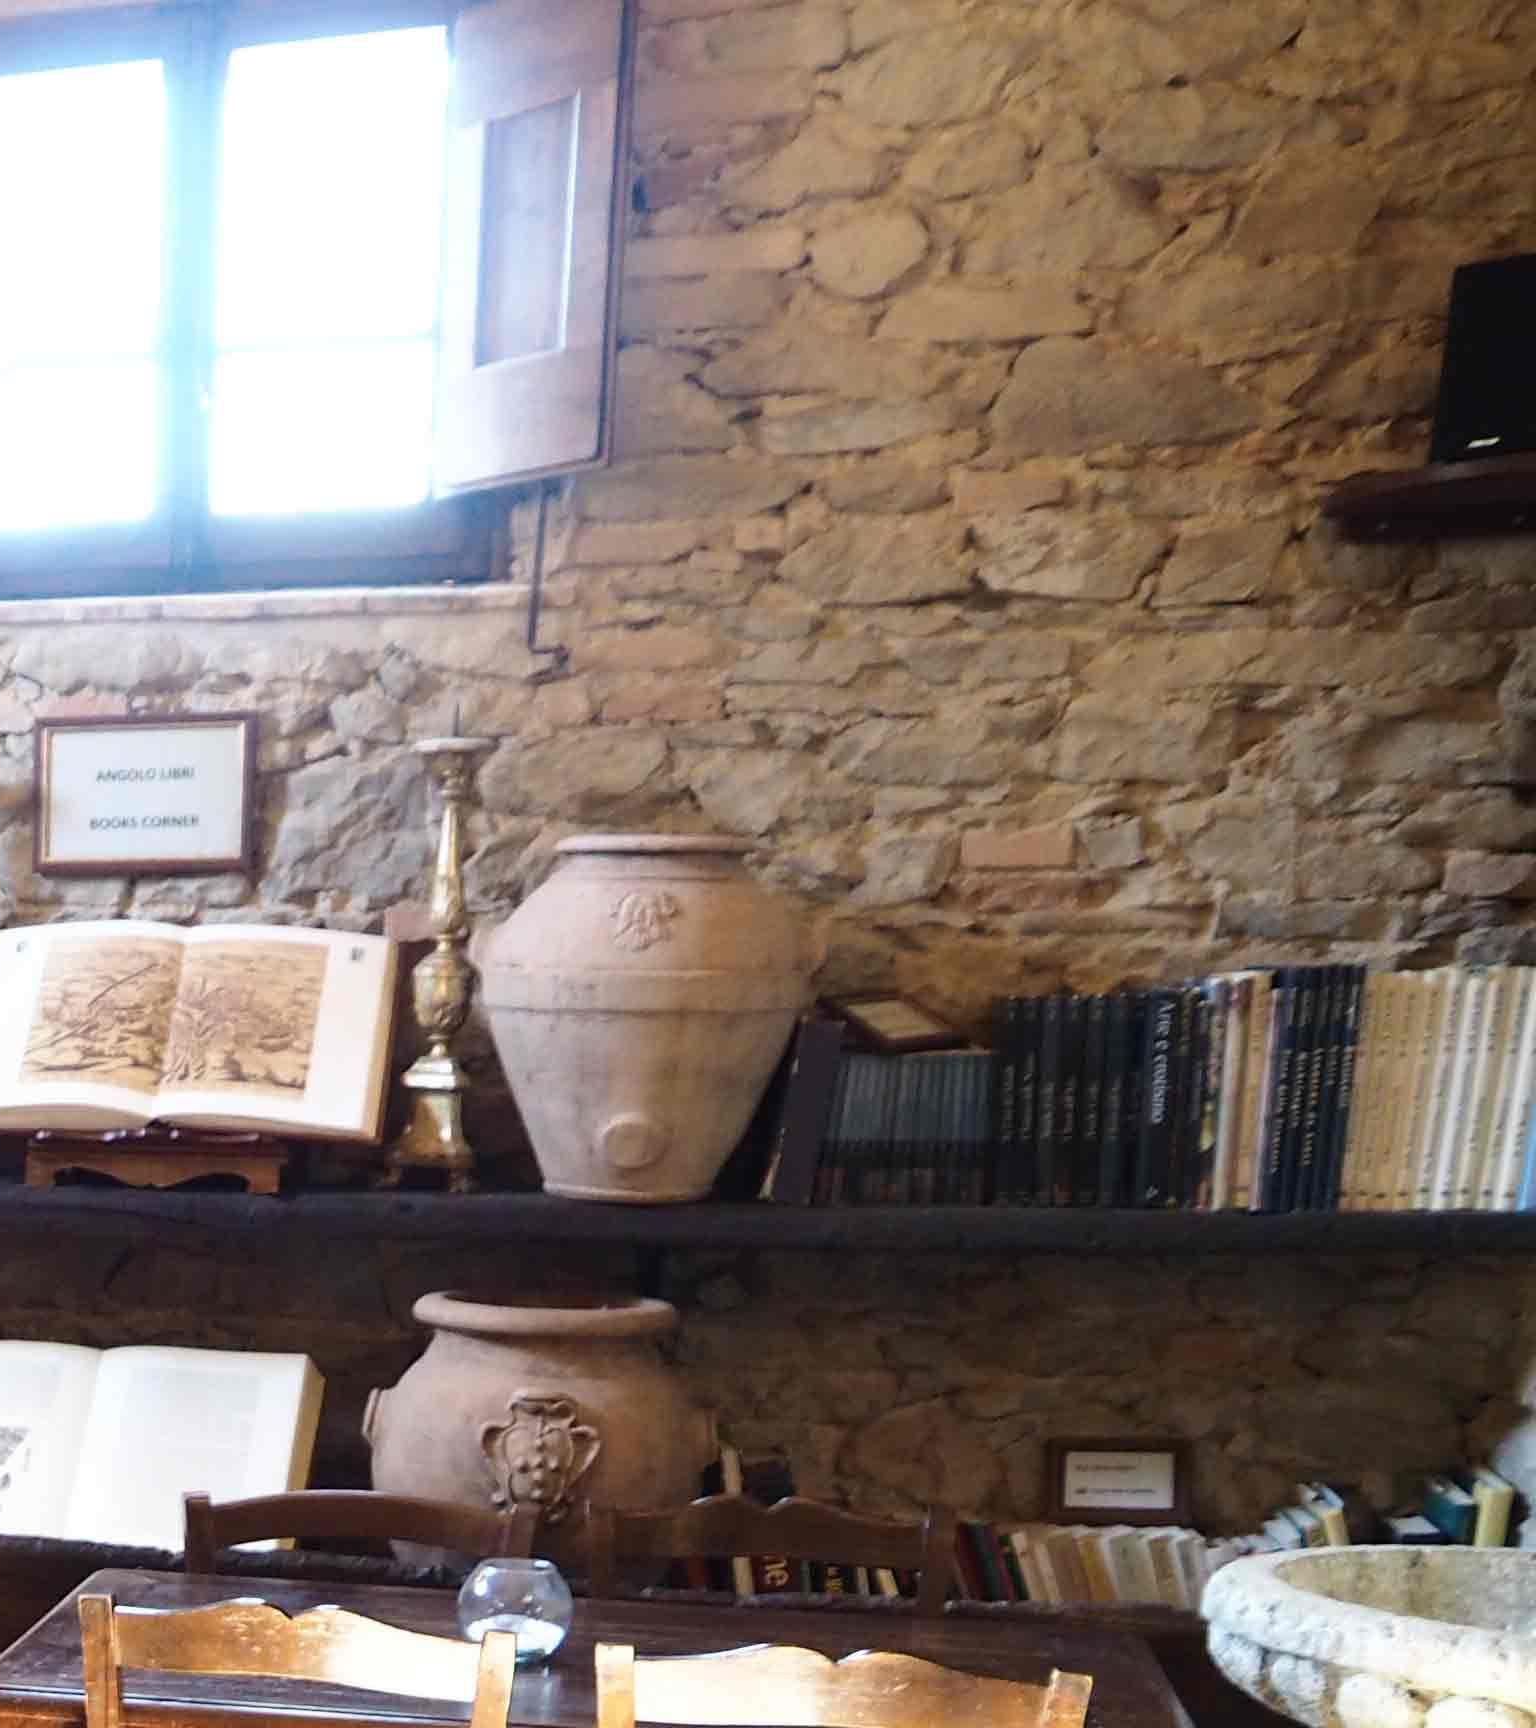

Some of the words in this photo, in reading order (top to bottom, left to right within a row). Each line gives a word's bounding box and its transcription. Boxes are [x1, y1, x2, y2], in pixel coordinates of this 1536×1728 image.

[96, 767, 158, 783] ANGOLO
[159, 766, 195, 780] LIBRI
[89, 816, 139, 831] BOOKS
[141, 814, 200, 829] CORNER
